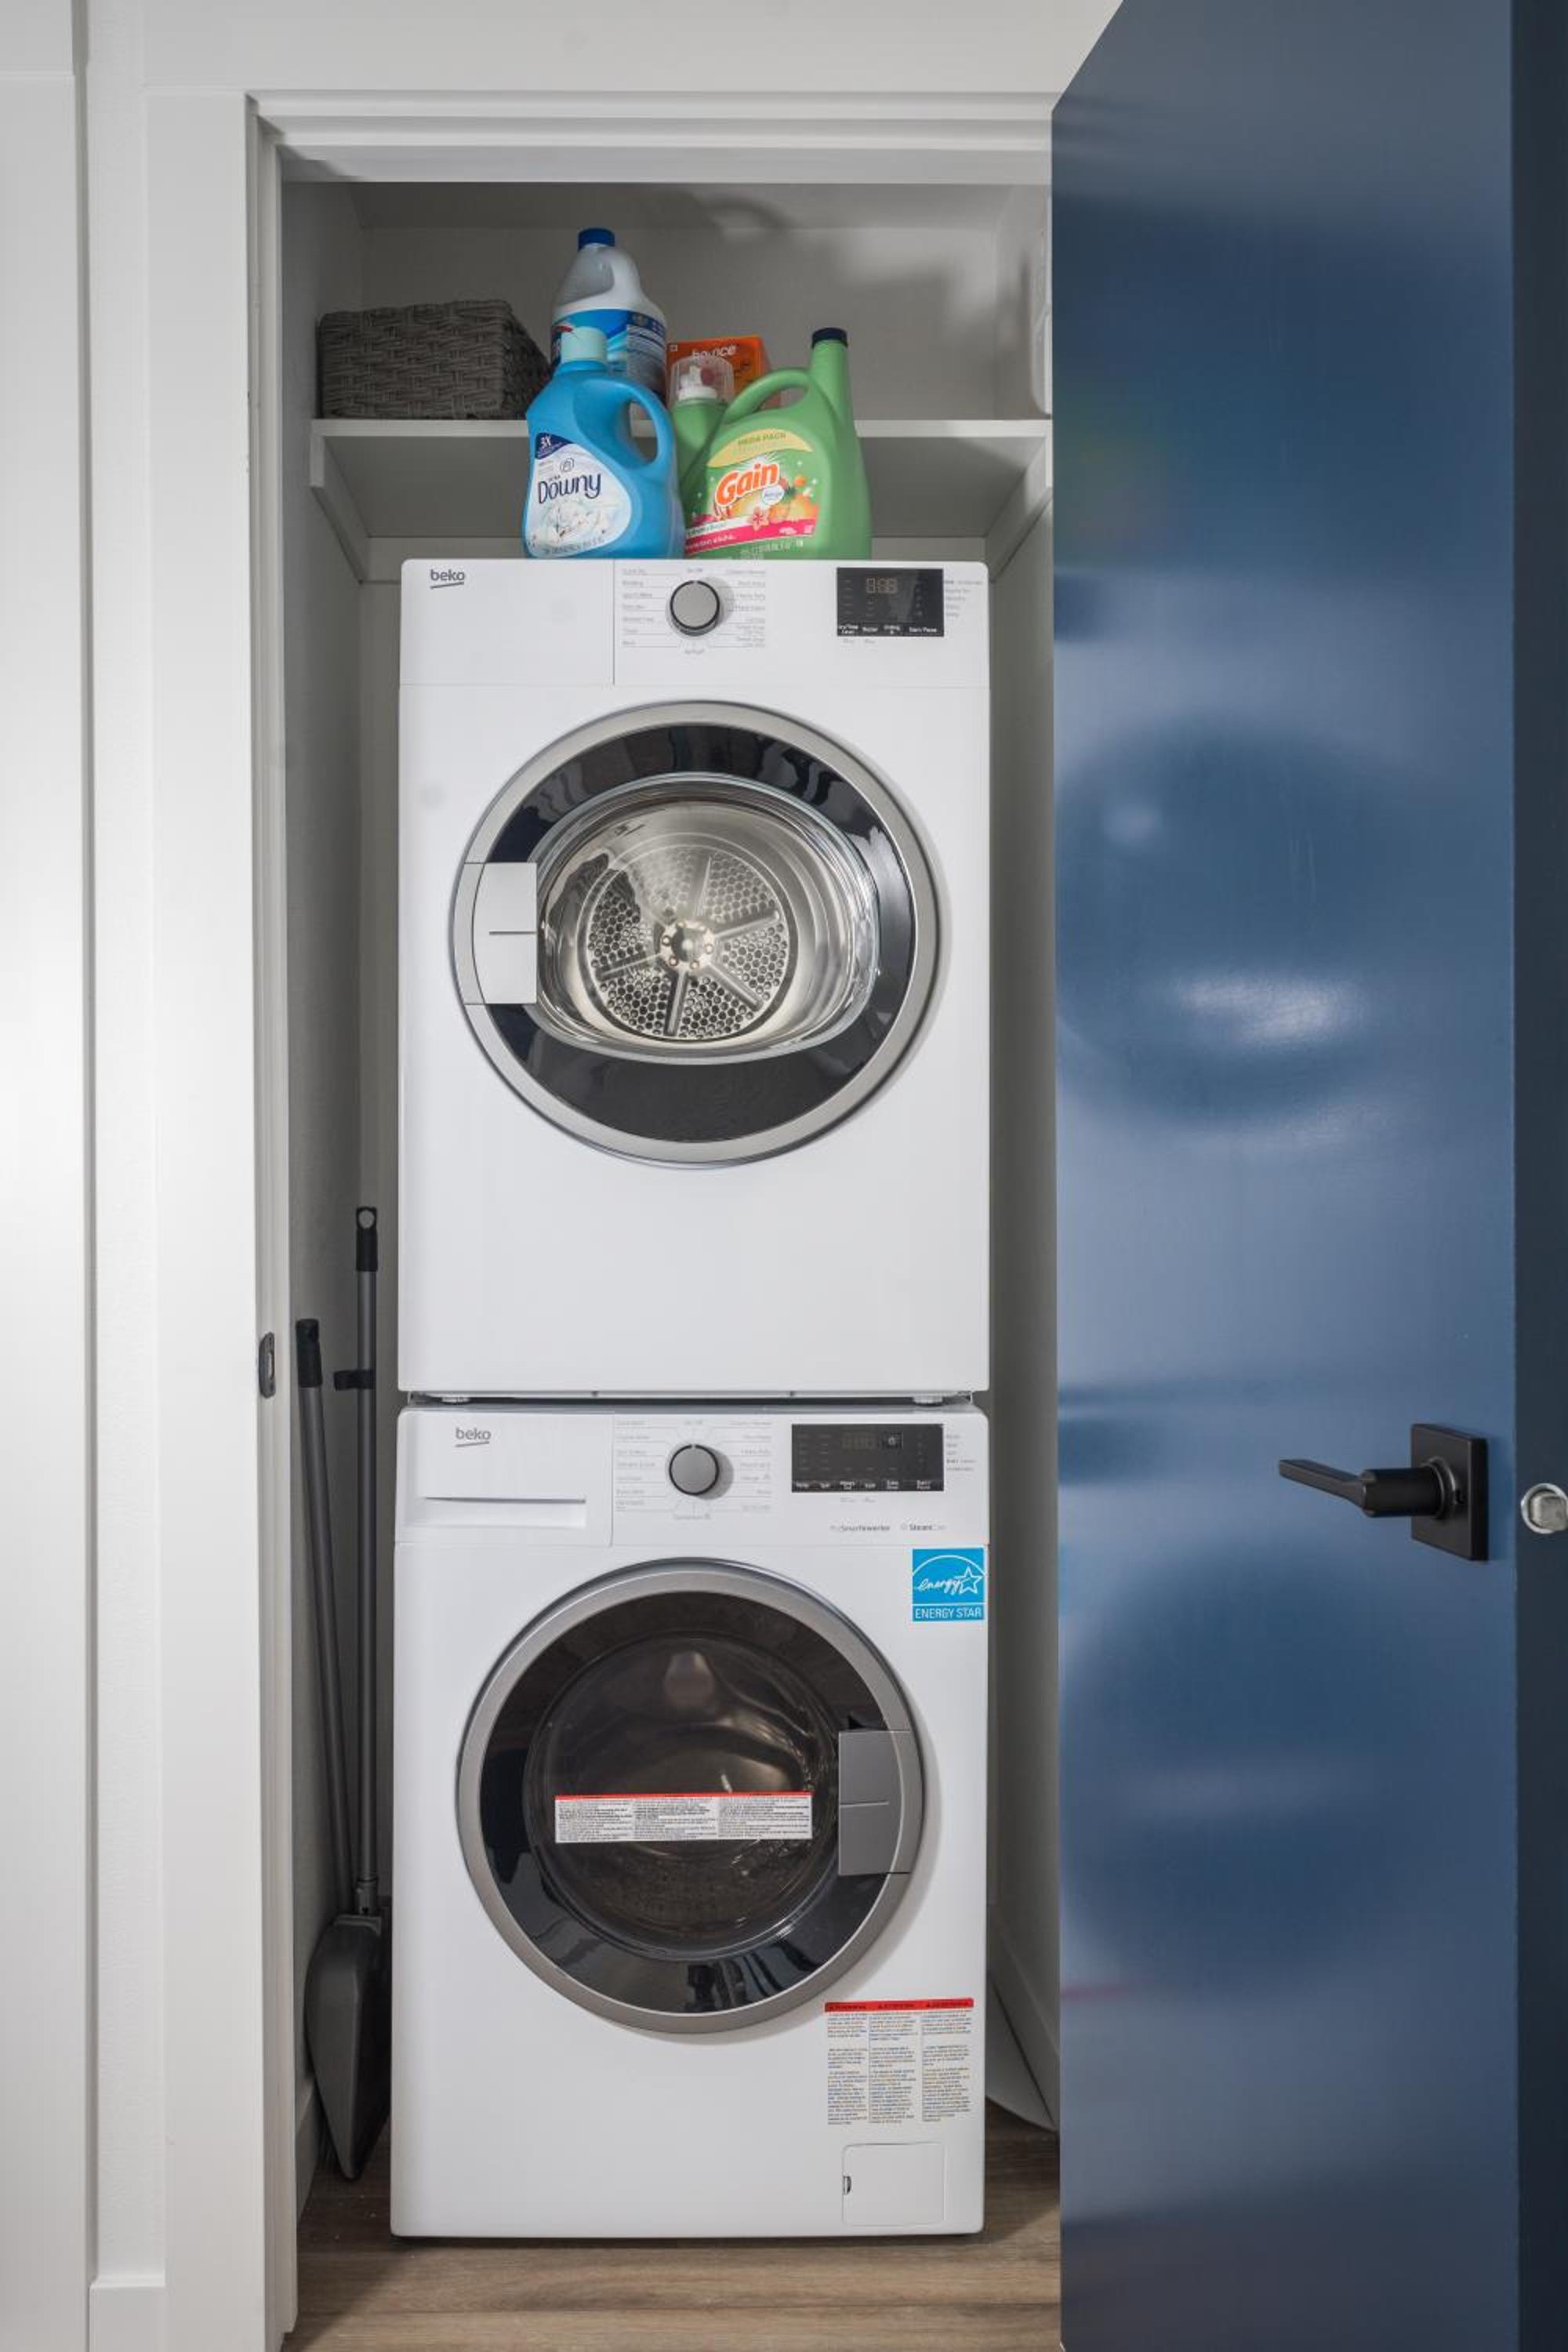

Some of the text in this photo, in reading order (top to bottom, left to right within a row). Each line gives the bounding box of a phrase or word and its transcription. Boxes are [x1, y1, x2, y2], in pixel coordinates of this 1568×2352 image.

[538, 473, 601, 504] Downy
[715, 462, 780, 506] Gain
[430, 568, 465, 581] beko
[456, 1427, 491, 1440] beko
[914, 1578, 961, 1595] energy
[915, 1606, 982, 1619] ENERGY STAR
